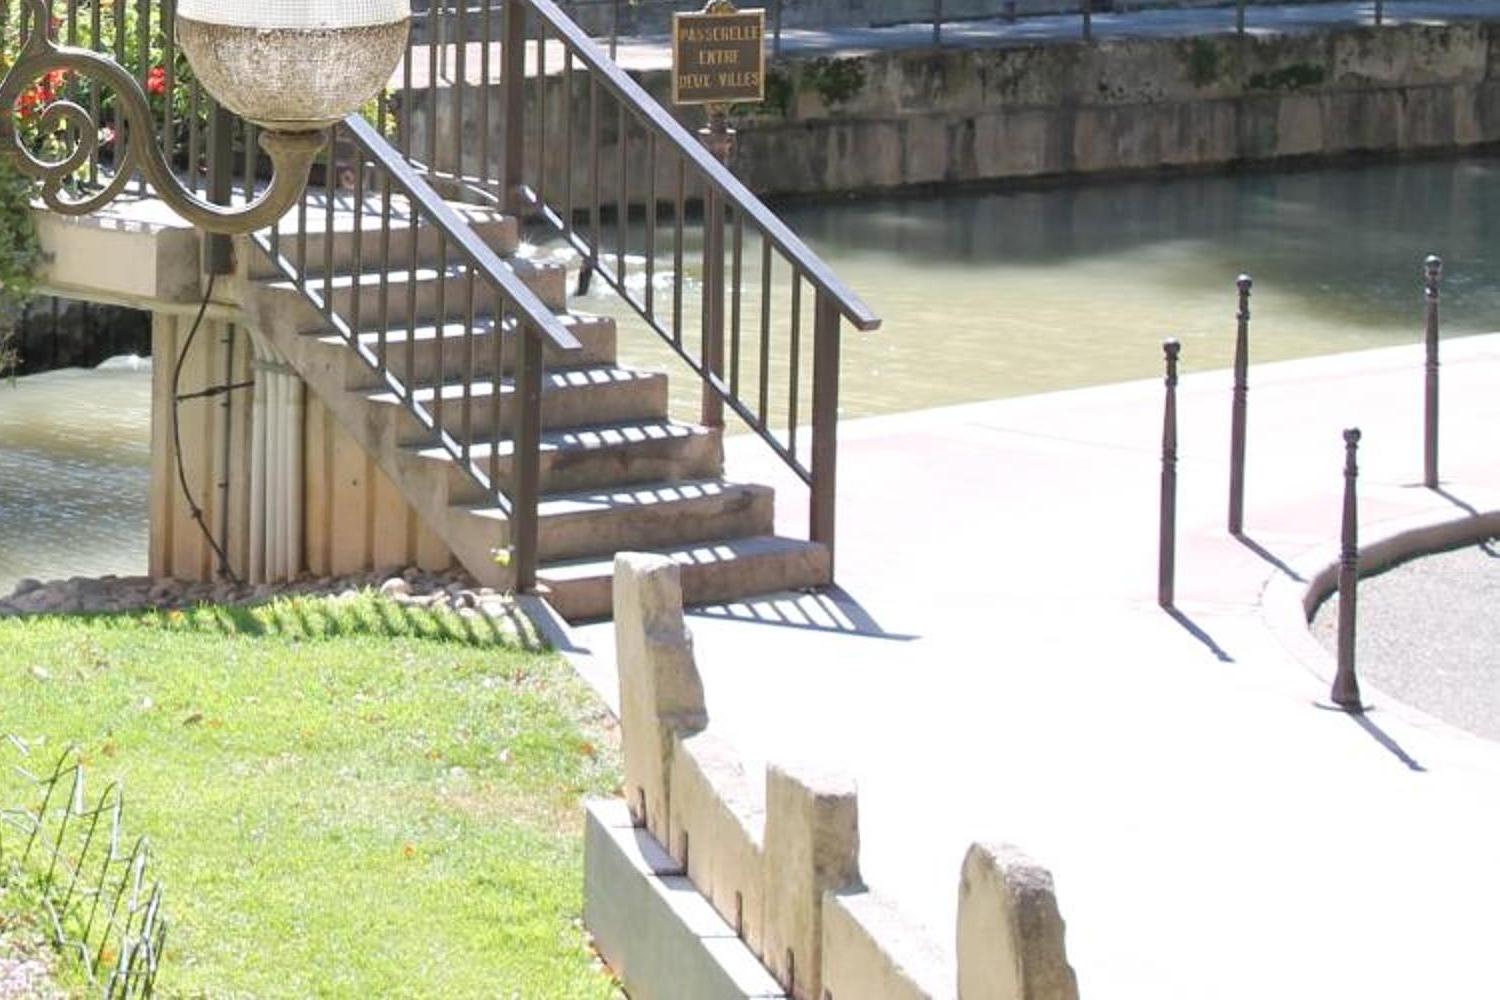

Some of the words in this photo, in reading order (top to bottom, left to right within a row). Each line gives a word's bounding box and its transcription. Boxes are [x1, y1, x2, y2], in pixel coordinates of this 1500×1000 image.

[679, 25, 760, 41] PASSERELLE
[699, 49, 740, 65] ENTRE
[679, 73, 709, 89] DEUX
[719, 71, 758, 88] VILLES
